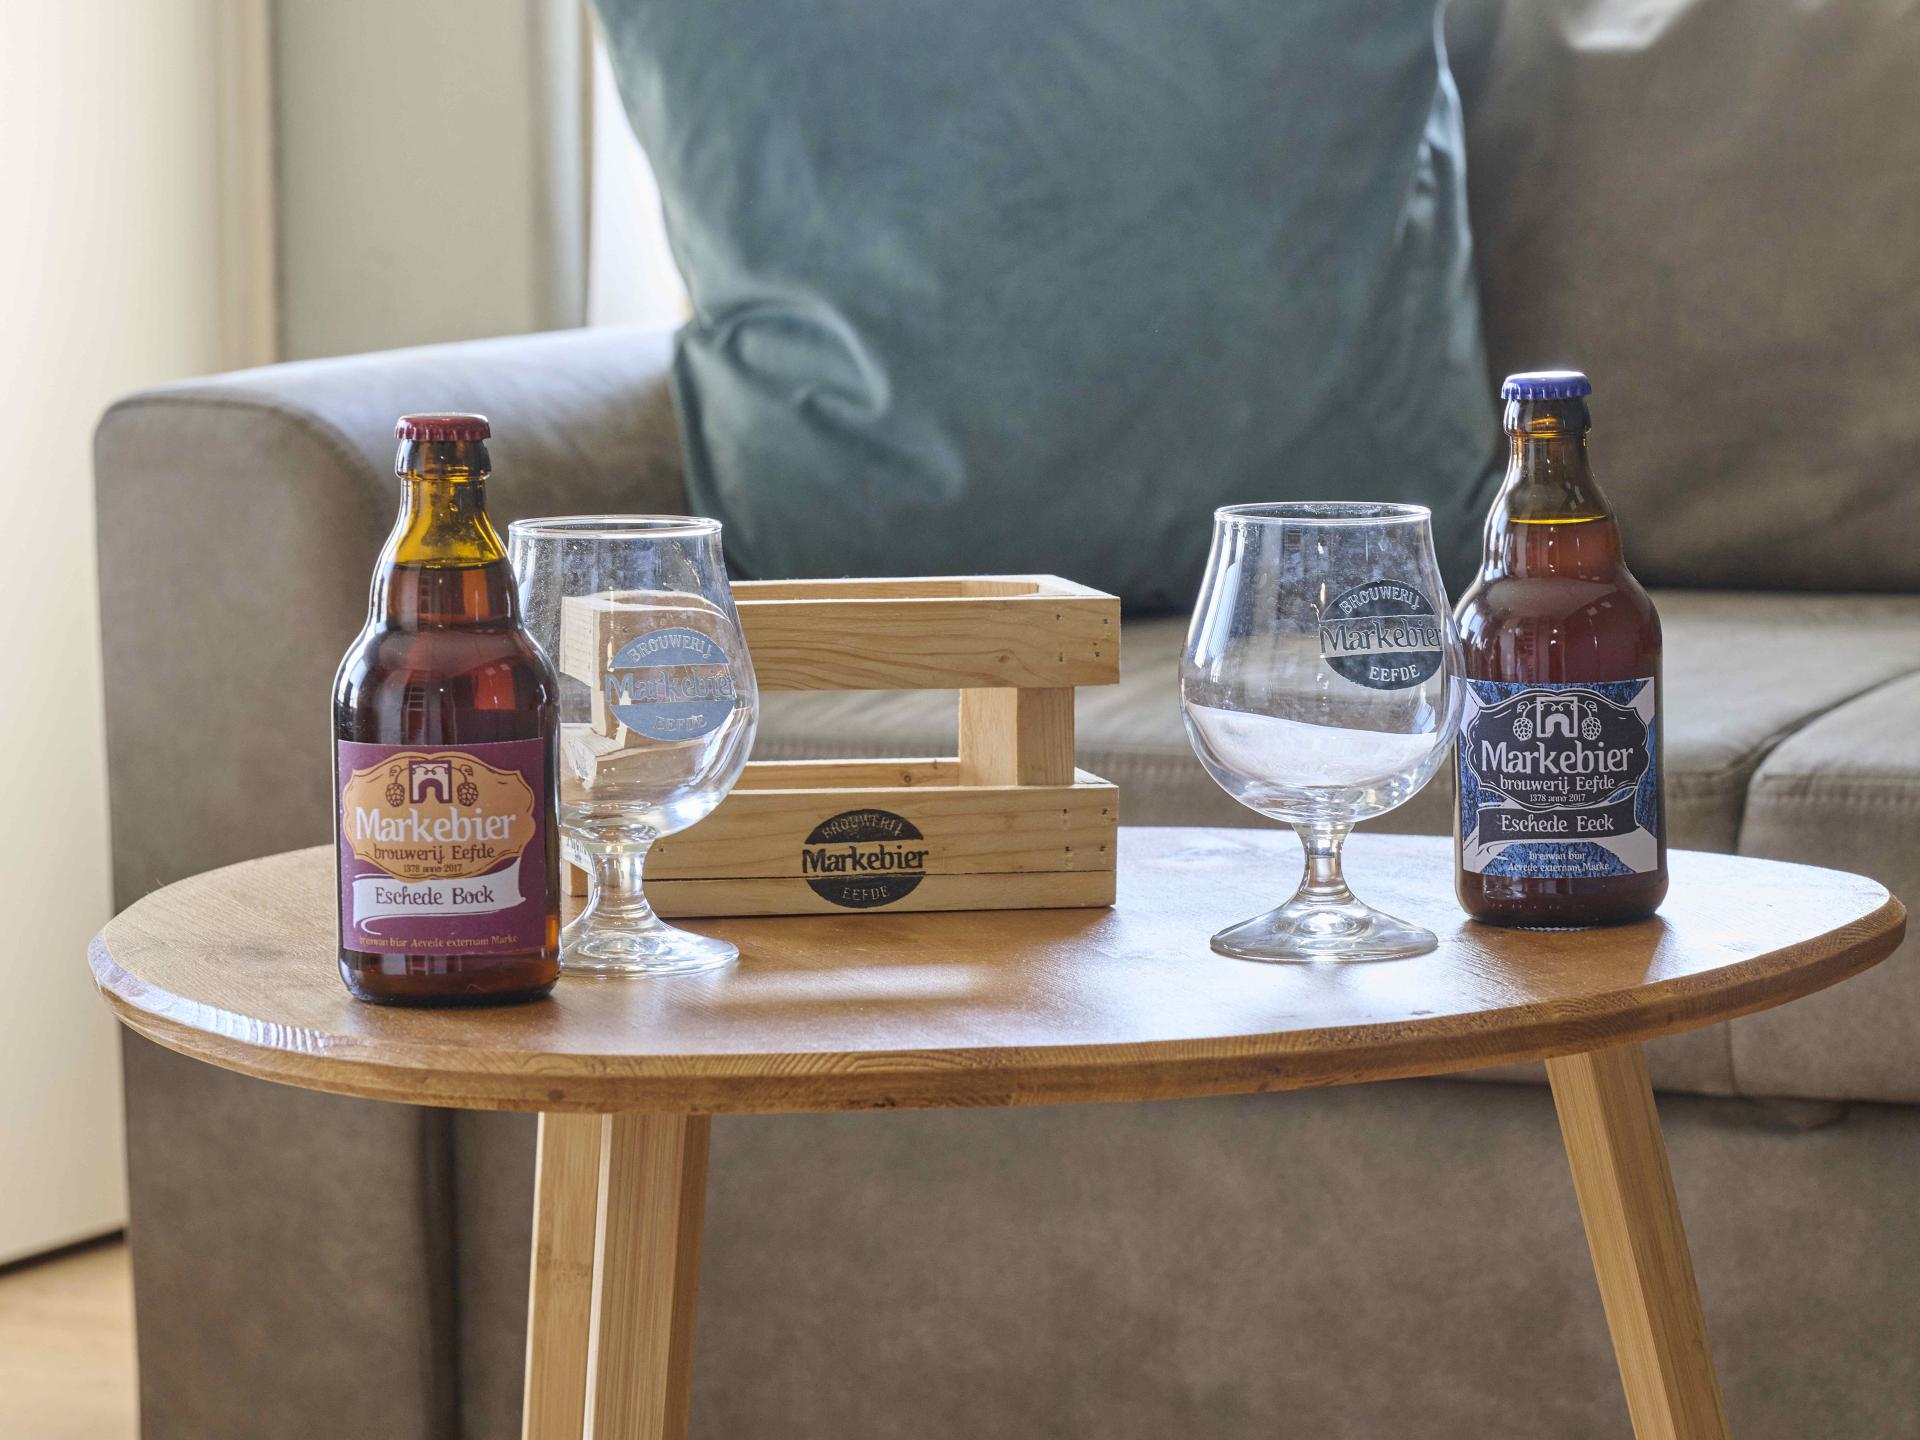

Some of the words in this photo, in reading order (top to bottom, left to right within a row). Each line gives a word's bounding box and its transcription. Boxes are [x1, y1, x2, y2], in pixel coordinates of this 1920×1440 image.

[1339, 586, 1422, 615] BROUWERIJ
[1320, 616, 1442, 654] Markebier
[627, 634, 713, 664] BROUWERIJ
[1369, 664, 1421, 682] EEFDE
[1481, 740, 1634, 774] Markebier
[1500, 775, 1569, 794] brouwerij
[1576, 776, 1615, 794] Eefde
[1530, 793, 1547, 802] 1378
[1568, 793, 1586, 802] 2017
[355, 806, 517, 842] Markebier
[1501, 814, 1569, 833] Eschede
[1577, 813, 1615, 832] Eeck
[373, 843, 445, 864] brouwerij
[452, 842, 496, 863] Eefde
[802, 844, 929, 874] Markebier
[403, 864, 420, 873] 1378
[444, 863, 463, 872] 2017
[375, 886, 444, 906] Eschede
[452, 885, 495, 905] Bock
[843, 886, 889, 901] EEFDE
